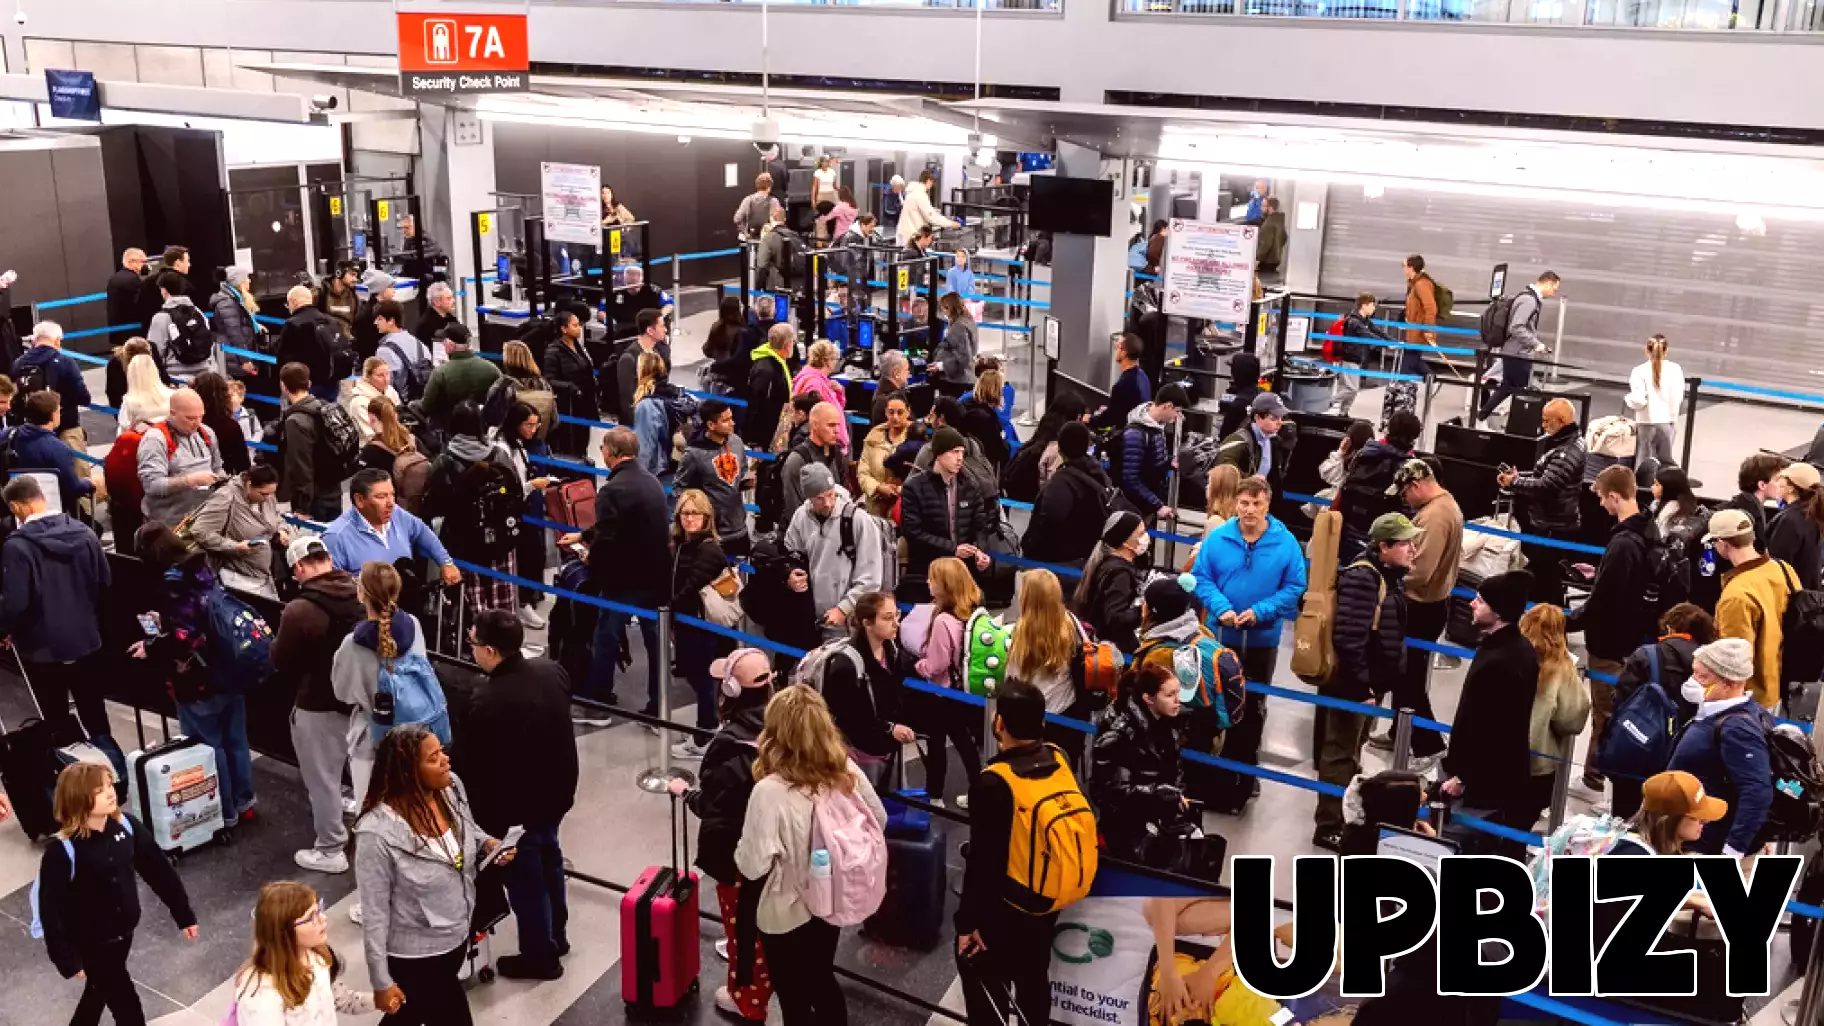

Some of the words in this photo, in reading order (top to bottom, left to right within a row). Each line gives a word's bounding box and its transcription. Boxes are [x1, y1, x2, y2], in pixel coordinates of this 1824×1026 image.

[464, 26, 505, 58] 7A
[412, 76, 457, 92] Security
[459, 75, 492, 89] Check
[495, 75, 520, 88] Point
[480, 219, 488, 233] 5
[1080, 987, 1095, 1002] to
[1097, 992, 1129, 1010] your
[1060, 999, 1122, 1025] checklist.
